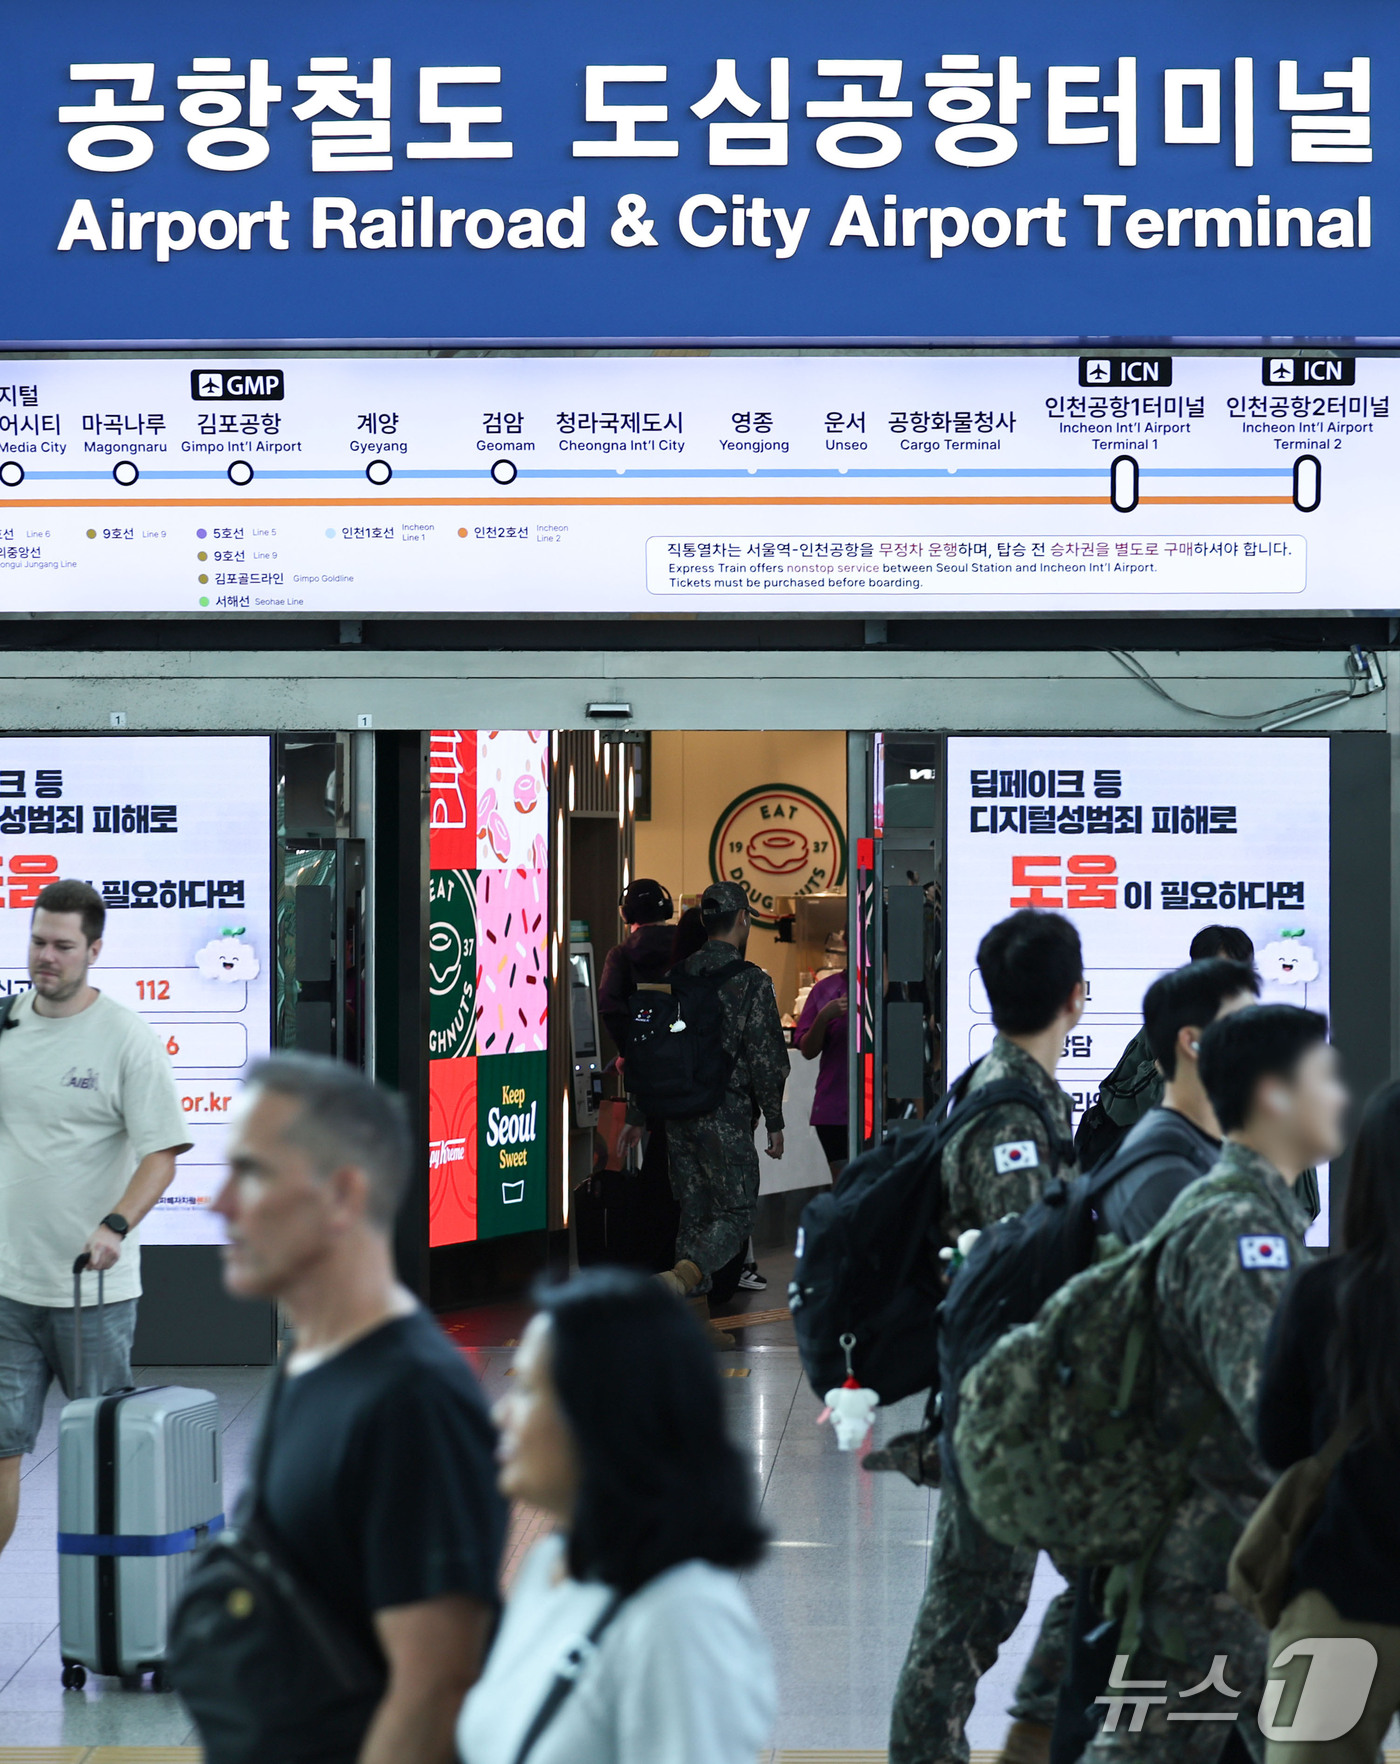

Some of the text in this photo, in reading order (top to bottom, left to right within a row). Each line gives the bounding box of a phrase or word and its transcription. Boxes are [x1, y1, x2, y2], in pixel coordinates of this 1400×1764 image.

[59, 55, 1372, 172] 공항철도 도심공항터미널
[57, 194, 1371, 262] Airport Railroad & City Airport Terminal
[1120, 362, 1158, 382] ICN
[1304, 360, 1342, 380] ICN
[226, 376, 280, 396] GMP
[0, 384, 38, 406] 지털
[1046, 396, 1204, 418] 인천공항1터미널
[1226, 396, 1388, 418] 인천공항2터미널
[0, 414, 60, 436] 어시티
[82, 414, 166, 436] 마곡나루
[198, 412, 282, 434] 김포공항
[358, 412, 398, 434] 계양
[482, 412, 524, 434] 검암
[556, 412, 682, 434] 청라국제도시
[732, 412, 774, 434] 영종
[824, 412, 864, 434] 운서
[888, 410, 1016, 434] 공항화물청사
[1060, 422, 1112, 434] Incheon
[1144, 422, 1190, 436] Airport
[1242, 422, 1296, 432] Incheon
[1326, 422, 1374, 436] Airport
[0, 442, 66, 456] Media City
[84, 442, 168, 456] Magongnaru
[182, 440, 224, 454] Gimpo
[256, 440, 302, 454] Airport
[350, 440, 408, 454] Gyeyang
[476, 440, 536, 452] Geomam
[558, 440, 626, 454] Cheongna
[658, 440, 684, 454] City
[720, 440, 790, 454] Yeongjong
[826, 440, 868, 450] Unseo
[900, 438, 1000, 452] Cargo Terminal
[1092, 438, 1158, 450] Terminal 1
[1274, 438, 1342, 450] Terminal 2
[26, 530, 51, 538] Line 6
[102, 528, 134, 540] 9호선
[142, 530, 160, 538] Line
[214, 528, 244, 540] 5호선
[252, 528, 270, 536] Line
[342, 526, 394, 540] 인천1호선
[474, 526, 528, 538] 인천2호선
[536, 534, 561, 542] Line 2
[214, 550, 244, 562] 9호선
[254, 552, 278, 560] Line 9
[668, 542, 1292, 558] 직통열차는 서울역-인천공항을 무정차 운행하며, 탑승 전 승차권을 별도로 구매하셔야 합니다.
[24, 560, 58, 570] Jungang
[668, 564, 714, 574] Express
[718, 564, 746, 572] Train
[750, 562, 784, 572] offers
[786, 564, 834, 574] nonstop
[838, 564, 880, 572] service
[882, 564, 932, 572] between
[936, 562, 968, 572] Seoul
[972, 562, 1012, 572] Station
[1016, 562, 1036, 572] and
[1040, 562, 1086, 572] Incheon
[1114, 562, 1156, 574] Airport.
[216, 572, 284, 586] 김포골드라인
[292, 574, 354, 584] Gimpo Goldline
[670, 578, 922, 590] Tickets must be purchased before boarding.
[216, 596, 250, 608] 서해선
[254, 598, 286, 606] Seohae
[34, 770, 62, 798] 등
[970, 770, 1086, 798] 딥페이크
[1094, 770, 1122, 798] 등
[0, 804, 178, 834] 성범죄 피해로
[759, 804, 798, 820] EAT
[970, 804, 1238, 834] 디지털성범죄 피해로
[730, 842, 744, 854] 19
[814, 842, 828, 854] 37
[100, 880, 246, 910] 필요하다면
[1160, 880, 1304, 910] 필요하다면
[464, 938, 474, 956] 37
[136, 980, 170, 1000] 112
[502, 1086, 526, 1108] Keep
[487, 1100, 536, 1146] Seoul
[500, 1148, 528, 1168] Sweet
